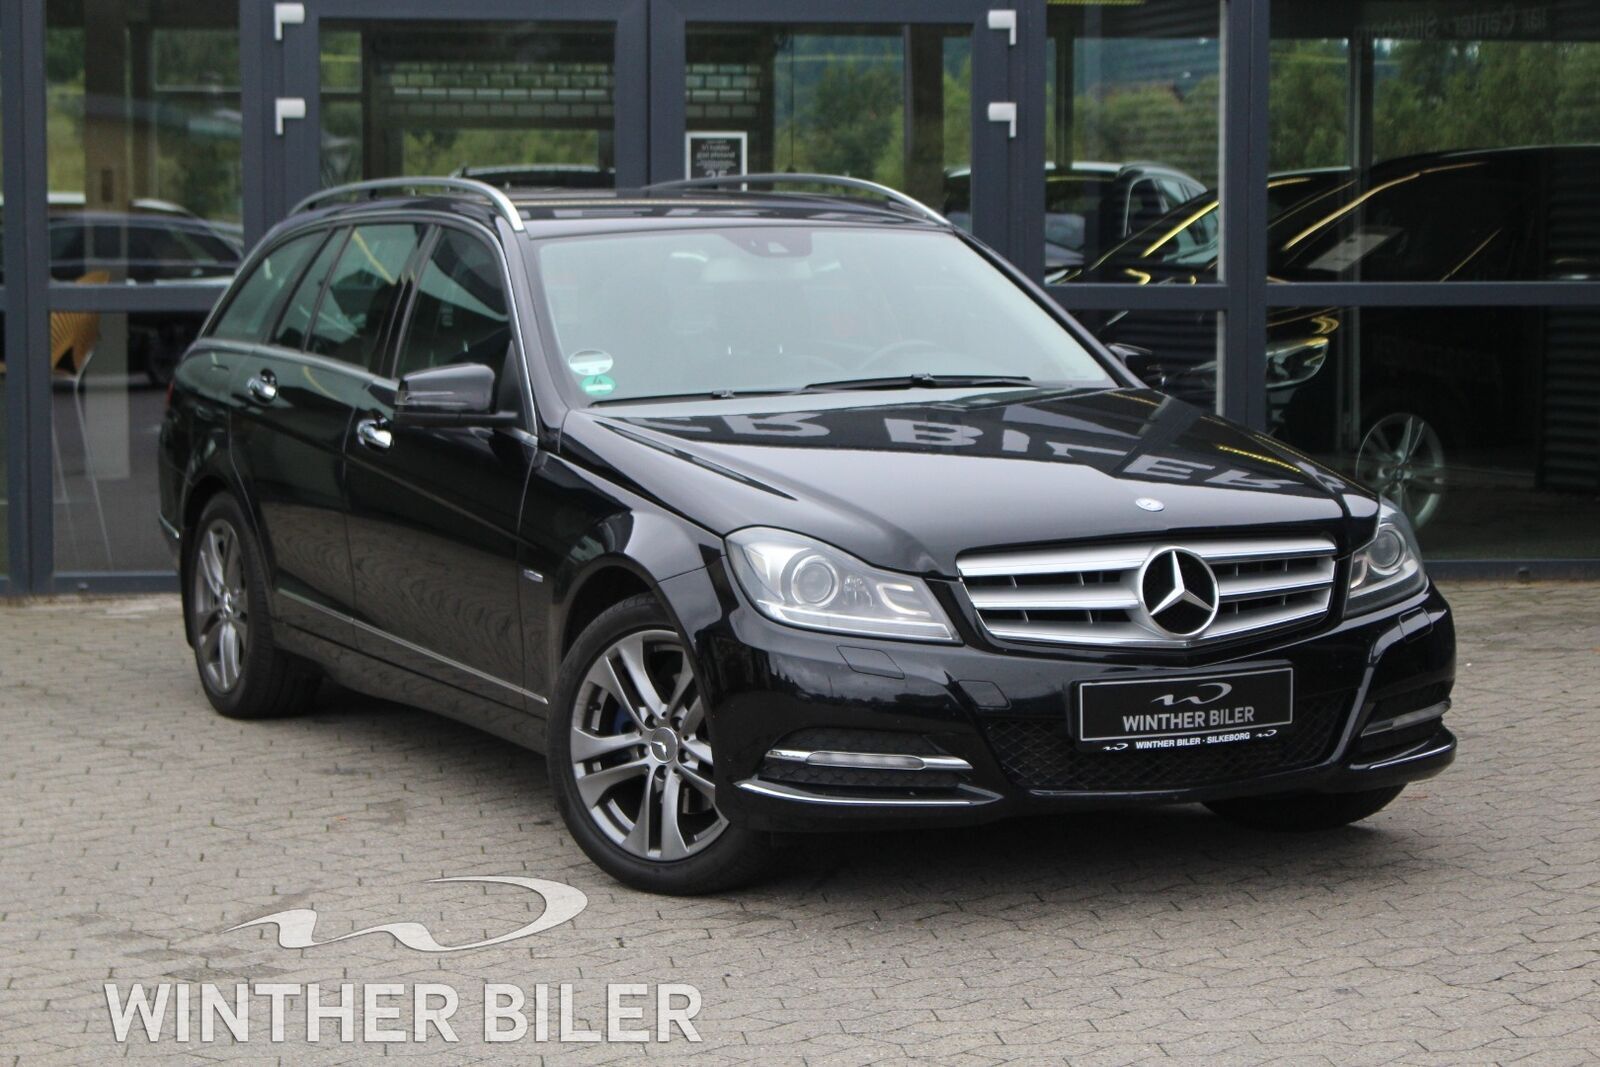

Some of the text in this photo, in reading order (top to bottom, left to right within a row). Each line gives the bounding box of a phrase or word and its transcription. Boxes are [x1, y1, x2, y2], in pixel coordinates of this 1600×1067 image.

[1122, 706, 1255, 732] WINTHER BILER
[1135, 732, 1250, 750] WINTHER BILER SILKEBORG
